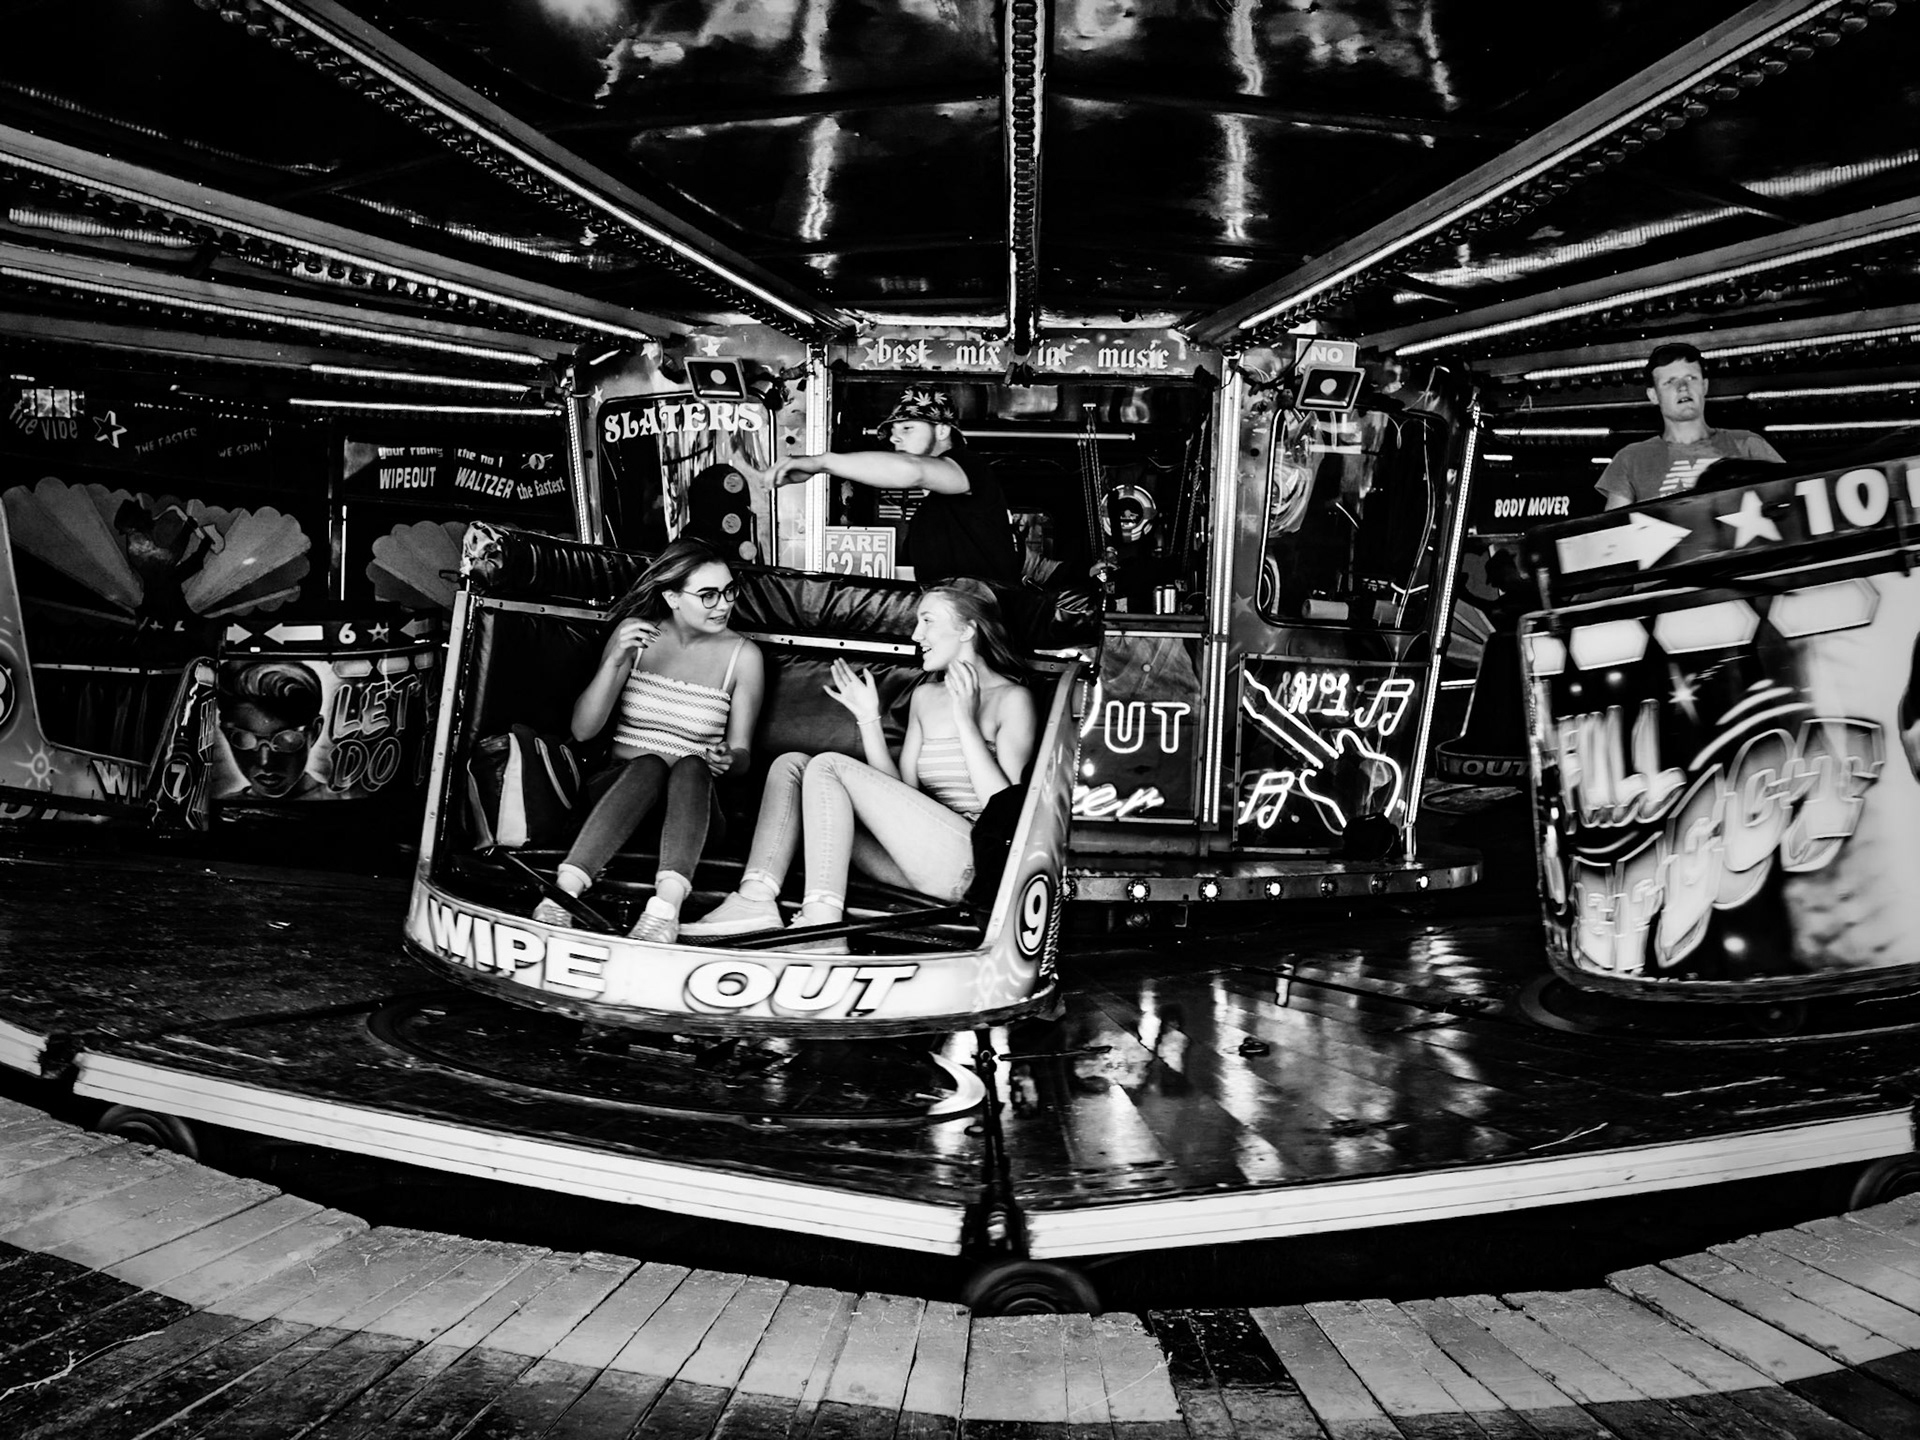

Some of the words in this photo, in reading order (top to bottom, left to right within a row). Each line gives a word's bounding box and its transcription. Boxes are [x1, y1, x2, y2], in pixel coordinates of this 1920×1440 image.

[876, 336, 930, 365] best
[955, 343, 1001, 366] mix
[1097, 342, 1169, 370] music
[1310, 345, 1343, 363] NO
[604, 402, 763, 443] SLATERS
[379, 465, 437, 490] WIPEOUT
[454, 466, 515, 500] WALTZER
[516, 482, 534, 500] the
[534, 476, 566, 498] fastest
[1494, 498, 1527, 519] BODY
[1527, 496, 1570, 518] MOVER
[1793, 467, 1890, 536] 10
[825, 534, 888, 553] FARE
[337, 622, 358, 645] 6
[1080, 679, 1191, 755] UT
[169, 762, 188, 800] 7
[1023, 878, 1050, 953] 9
[428, 894, 611, 996] WIPE
[683, 959, 922, 1016] OUT
